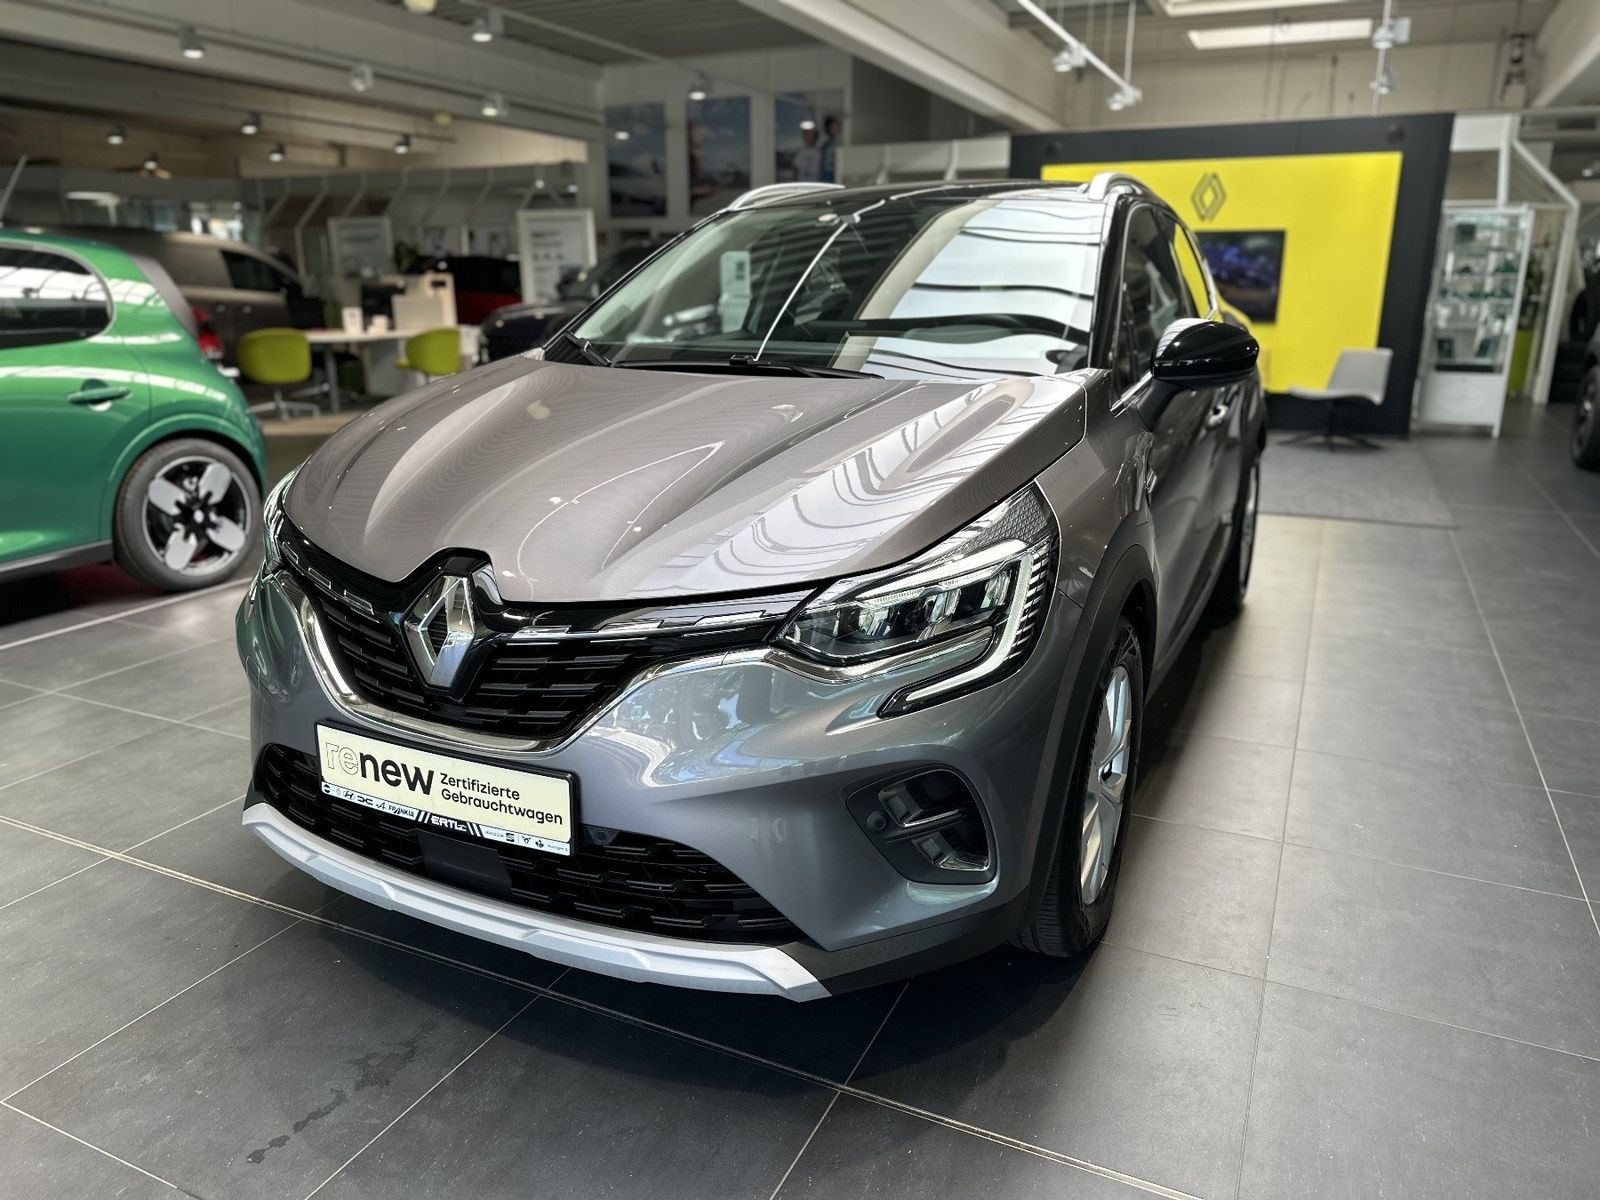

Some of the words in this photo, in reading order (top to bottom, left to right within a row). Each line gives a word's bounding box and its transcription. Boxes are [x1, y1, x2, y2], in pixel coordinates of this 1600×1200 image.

[325, 741, 434, 795] renew
[440, 772, 520, 801] Zertifizierte
[441, 788, 563, 825] Gebrauchtwagen
